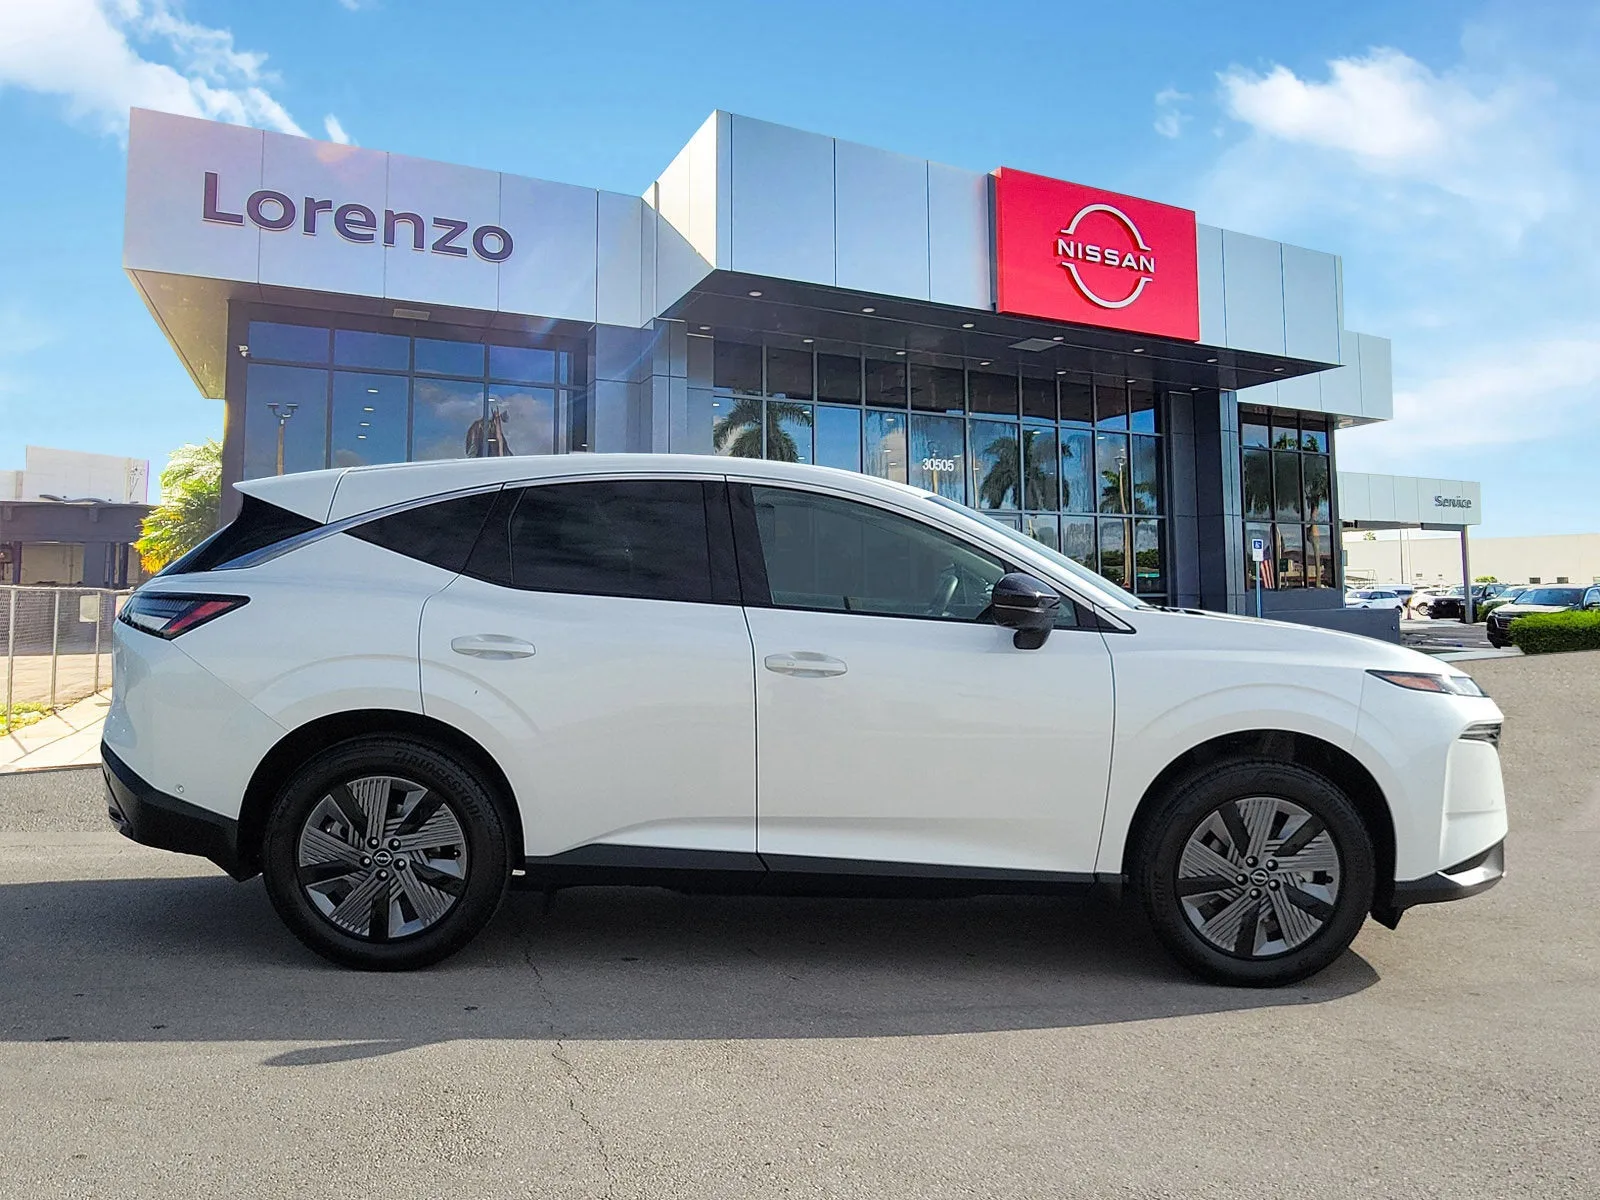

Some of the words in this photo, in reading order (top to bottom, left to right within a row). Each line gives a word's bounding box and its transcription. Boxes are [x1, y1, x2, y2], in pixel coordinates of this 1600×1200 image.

[202, 171, 514, 262] Lorenzo
[1057, 238, 1155, 273] NISSAN
[922, 457, 955, 472] 30505
[1434, 495, 1472, 509] Service
